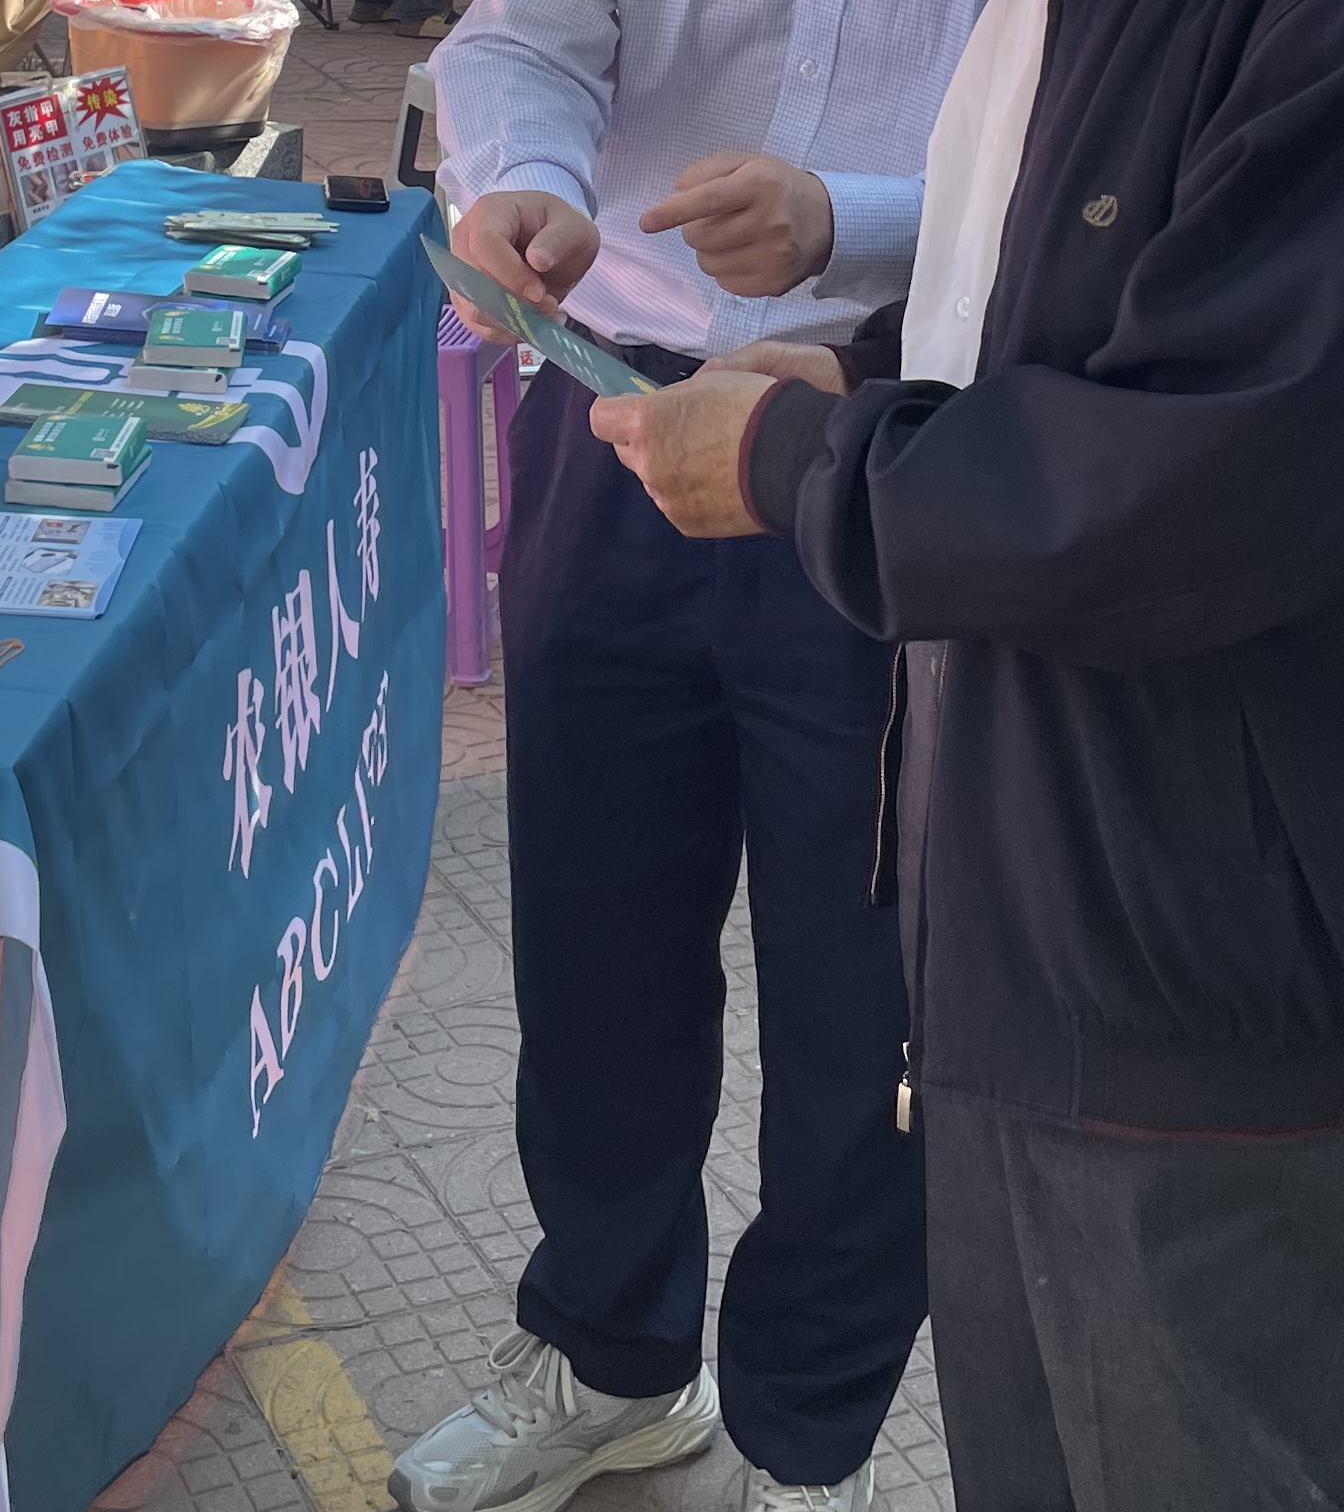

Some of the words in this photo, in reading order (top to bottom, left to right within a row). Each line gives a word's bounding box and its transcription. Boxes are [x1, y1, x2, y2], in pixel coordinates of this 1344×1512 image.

[6, 100, 55, 127] 灰指甲
[86, 88, 118, 112] 传染
[12, 119, 59, 148] 用亮甲
[82, 124, 133, 152] 免费体验
[17, 141, 74, 173] 免费检测
